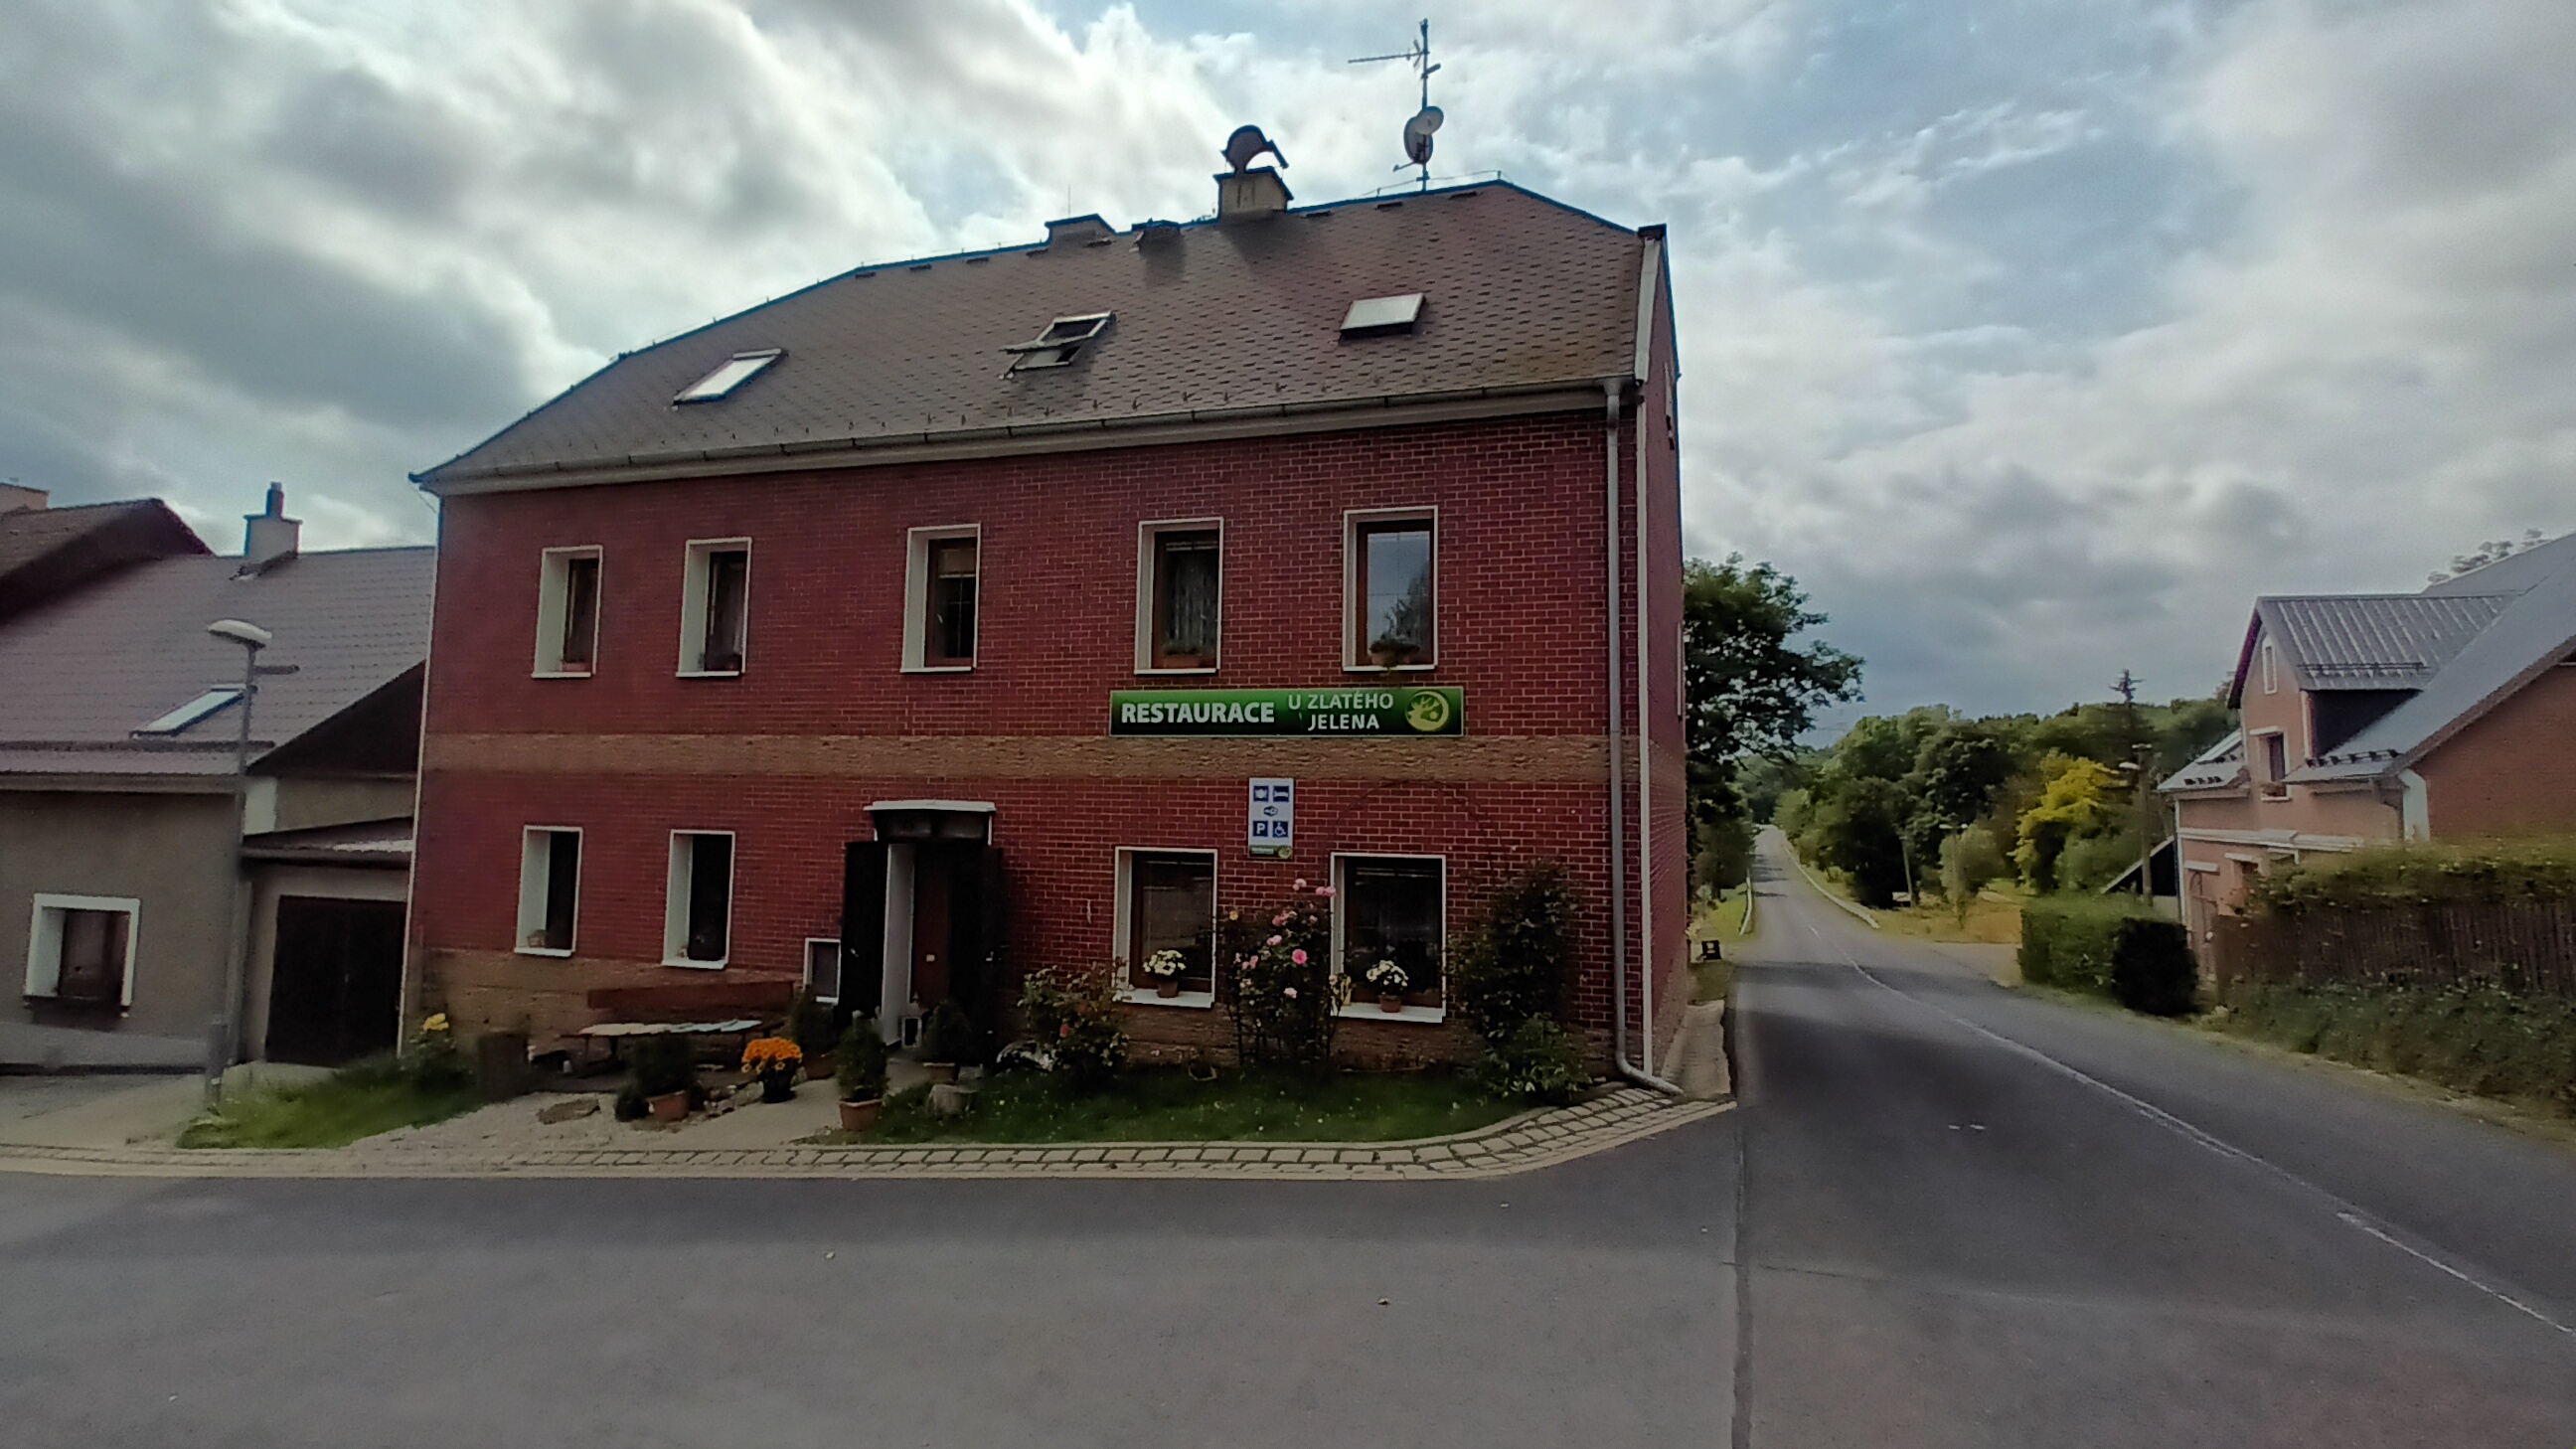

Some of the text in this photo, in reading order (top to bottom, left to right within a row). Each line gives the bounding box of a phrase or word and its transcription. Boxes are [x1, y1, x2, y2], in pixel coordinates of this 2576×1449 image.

[1288, 691, 1394, 710] U ZLATÉHO
[1121, 702, 1275, 724] RESTAURACE
[1308, 714, 1379, 731] JELENA
[1256, 822, 1266, 835] P
